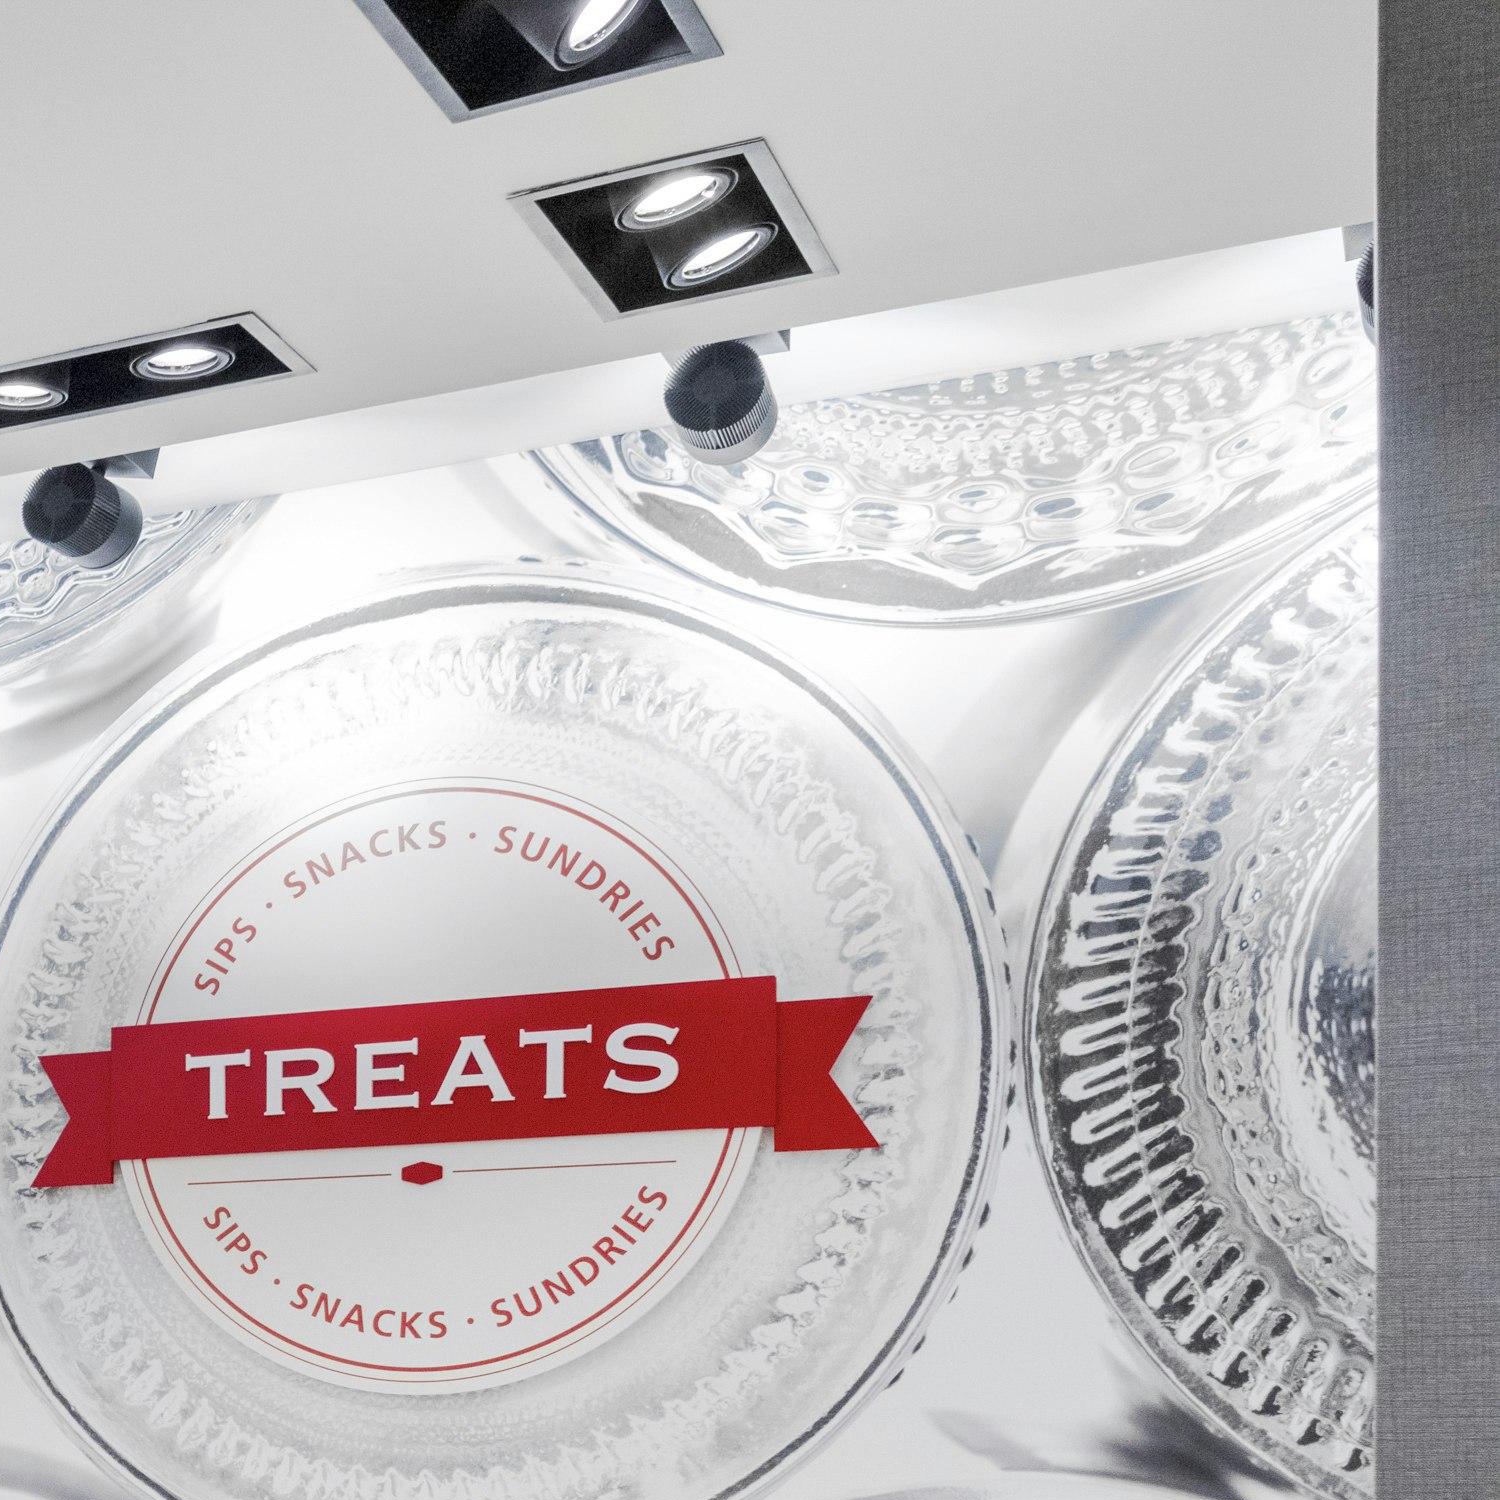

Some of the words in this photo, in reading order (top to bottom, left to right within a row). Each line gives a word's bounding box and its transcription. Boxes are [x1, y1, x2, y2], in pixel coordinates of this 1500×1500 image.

[194, 916, 258, 996] SIPS
[283, 819, 448, 900] SNACKS
[494, 825, 676, 962] SUNDRIES
[185, 1022, 681, 1121] TREATS
[203, 1205, 268, 1275] SIPS
[290, 1283, 448, 1339] SNACKS
[495, 1184, 669, 1327] SUNDRIES
